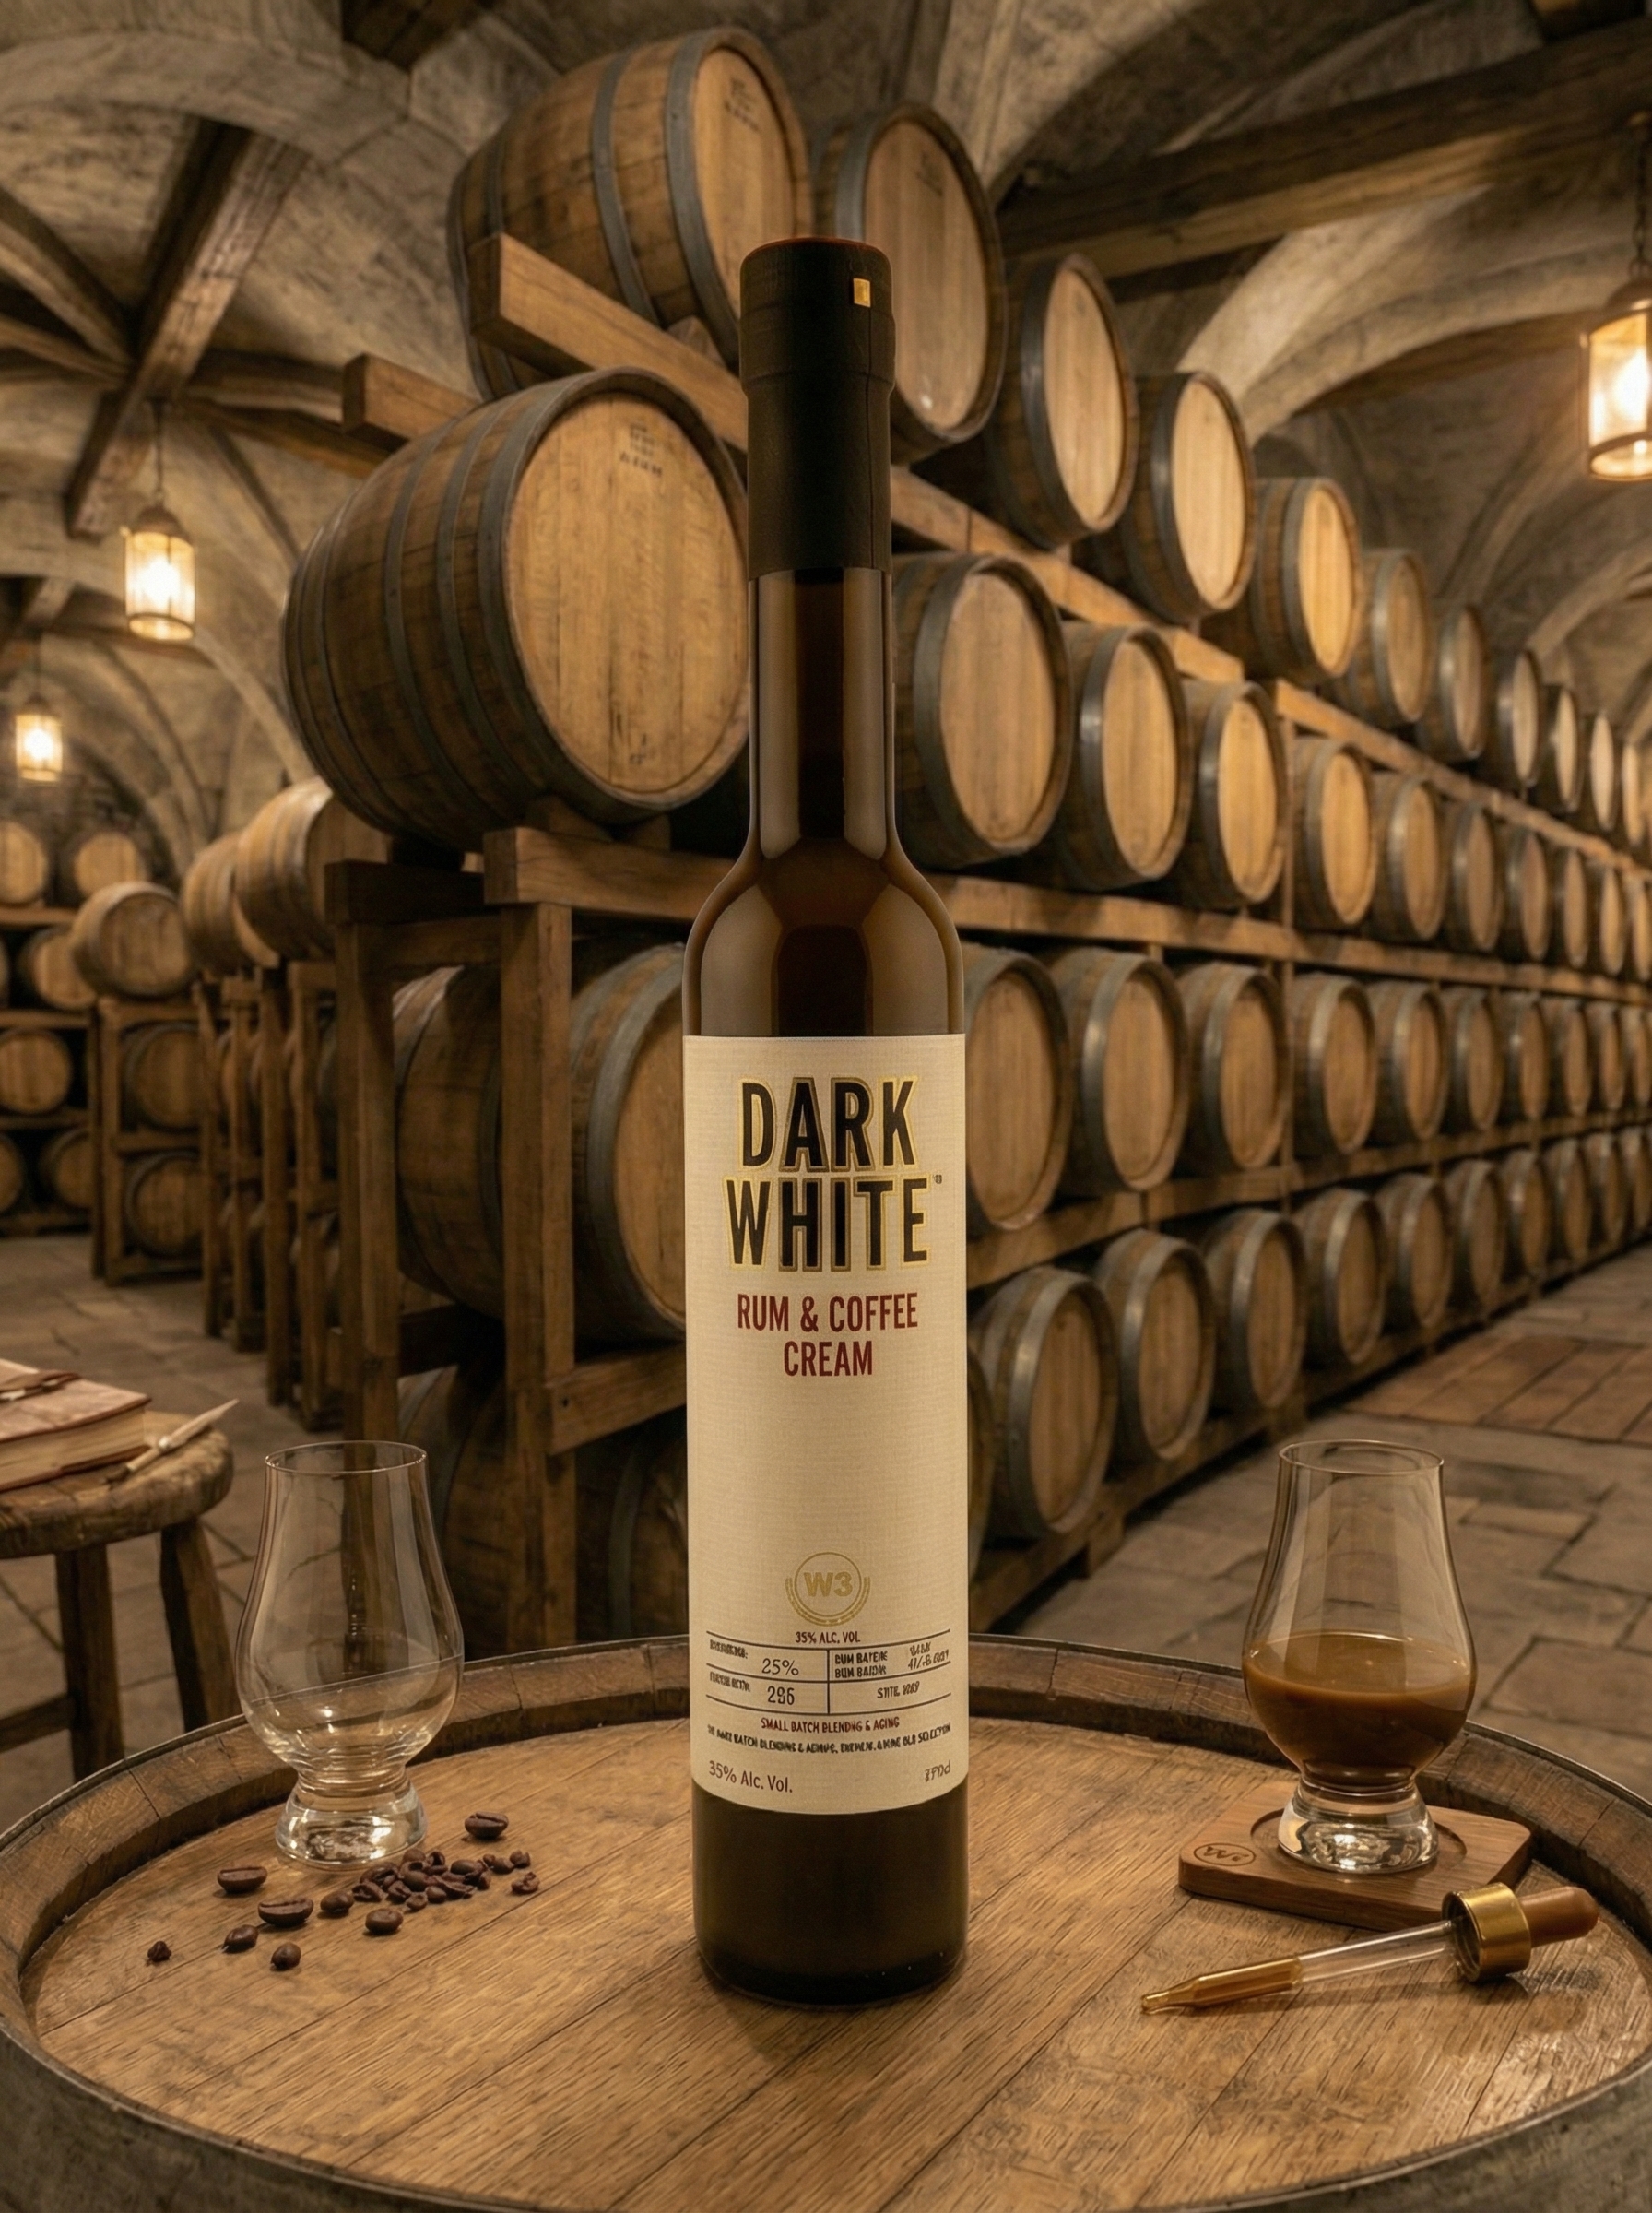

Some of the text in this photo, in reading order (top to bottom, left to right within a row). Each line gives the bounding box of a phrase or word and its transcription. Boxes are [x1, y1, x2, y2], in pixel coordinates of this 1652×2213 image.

[738, 1077, 918, 1172] DARK
[723, 1174, 931, 1272] WHITE
[738, 1292, 918, 1332] RUM & COFFEE
[784, 1341, 873, 1377] CREAM
[803, 1571, 853, 1597] W3
[796, 1631, 817, 1644] 35%
[761, 1658, 799, 1675] 25%
[873, 1716, 900, 1731] AGING
[709, 1760, 793, 1793] 35% Alc. Vol.
